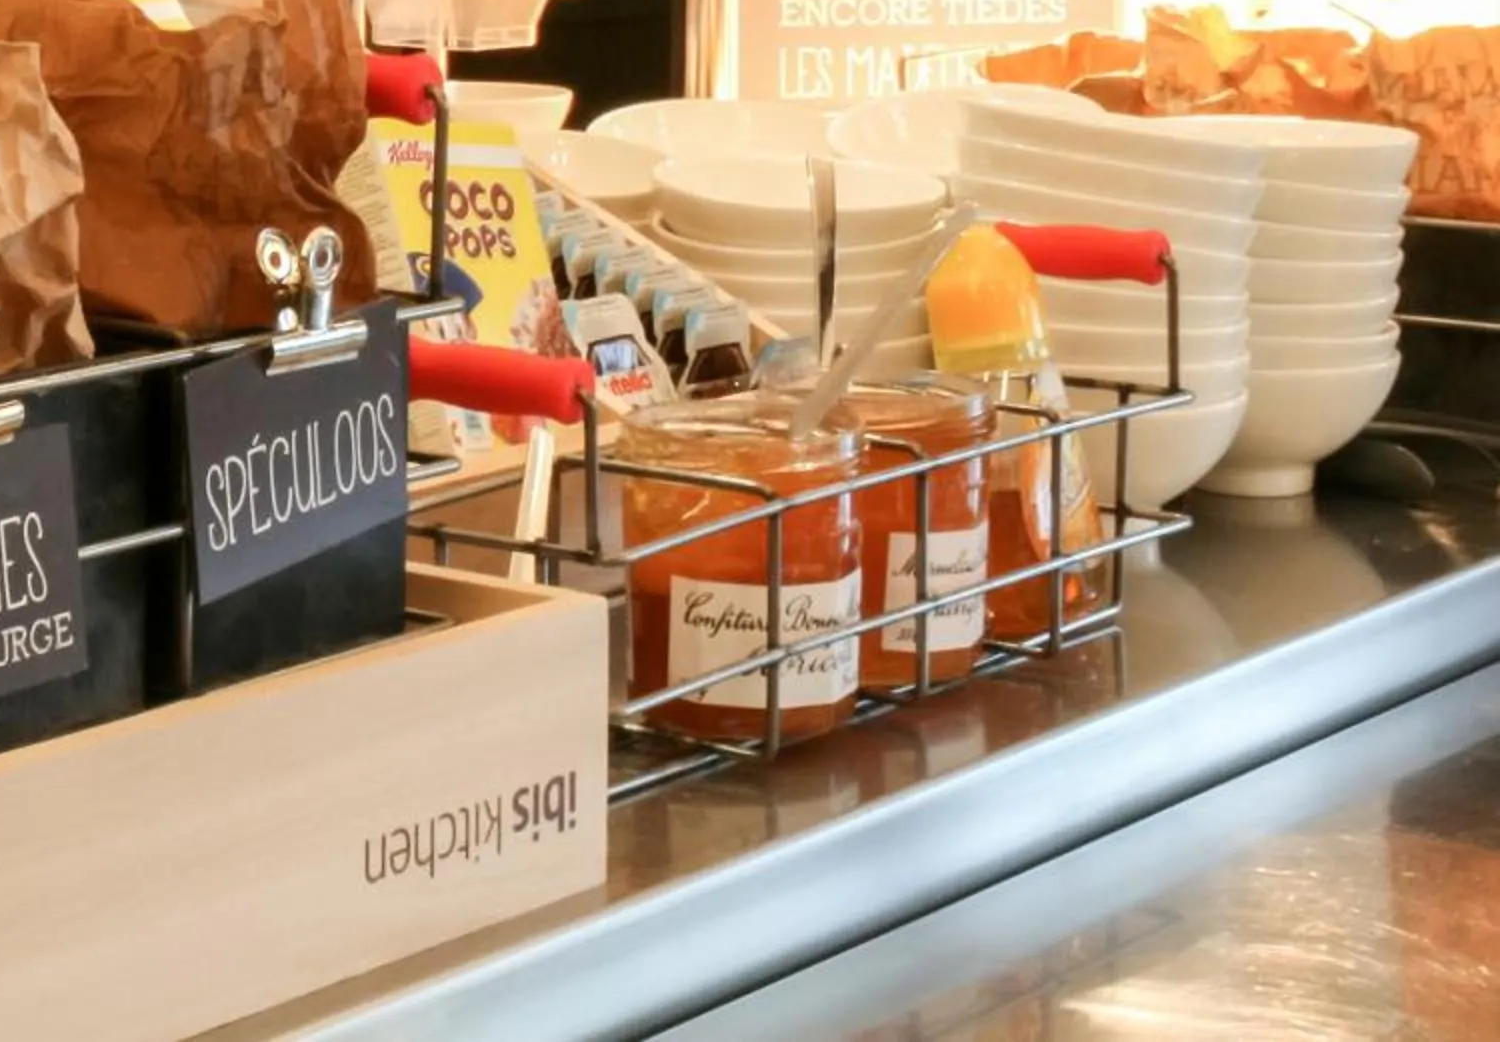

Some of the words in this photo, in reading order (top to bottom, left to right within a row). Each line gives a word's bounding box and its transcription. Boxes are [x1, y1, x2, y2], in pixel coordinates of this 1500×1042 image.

[443, 223, 517, 259] POPS
[205, 393, 398, 552] SPÉCULOOS
[684, 591, 769, 639] Confitur
[364, 795, 502, 885] kitchen
[511, 770, 577, 842] ibis
